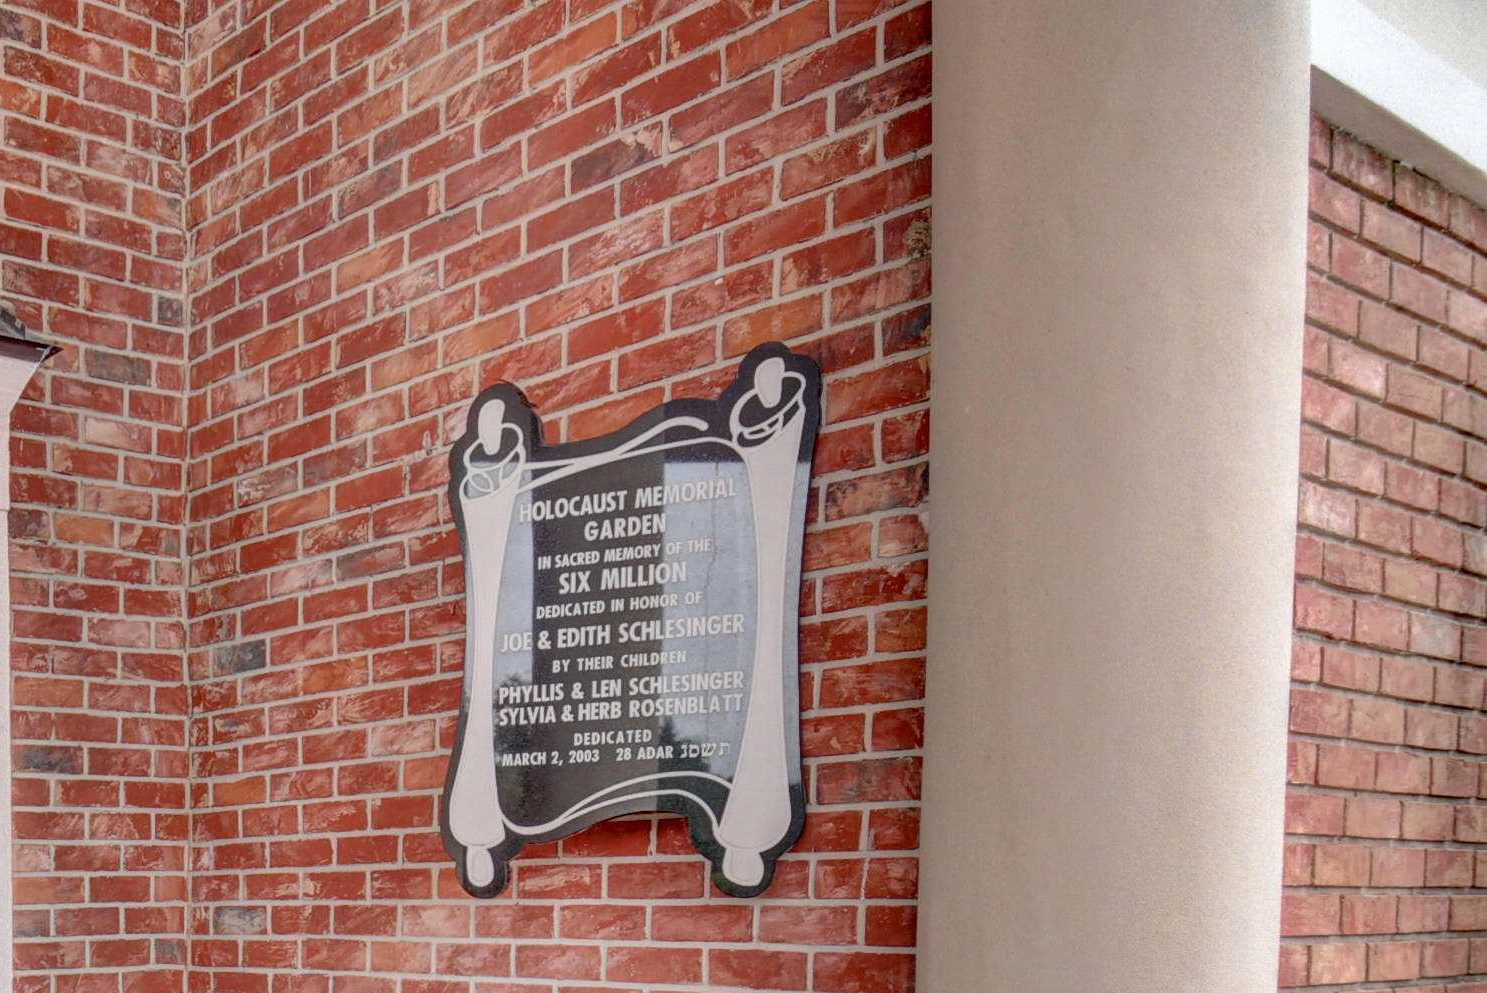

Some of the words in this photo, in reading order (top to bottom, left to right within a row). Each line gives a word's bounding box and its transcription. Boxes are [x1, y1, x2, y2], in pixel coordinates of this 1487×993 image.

[519, 490, 627, 522] HOLOCAUST
[635, 478, 737, 509] MEMORIAL
[584, 513, 666, 541] GARDEN
[538, 556, 551, 570] IN
[555, 550, 600, 568] SACRED
[604, 543, 661, 563] MEMORY
[666, 541, 682, 555] OF
[687, 538, 712, 552] THE
[558, 572, 590, 594] SIX
[601, 561, 687, 591] MILLION
[536, 600, 605, 620] DEDICATED
[611, 598, 624, 612] IN
[630, 593, 678, 611] HONOR
[685, 591, 703, 604] OF
[500, 632, 533, 653] JOE
[537, 631, 552, 650] &
[557, 624, 611, 649] EDITH
[618, 614, 745, 643] SCHLESINGER
[552, 659, 570, 673] BY
[577, 656, 614, 671] THEIR
[620, 650, 686, 668] CHILDREN
[499, 683, 564, 705] PHYLLIS
[571, 681, 585, 699] &
[591, 679, 622, 698] LEN
[629, 671, 744, 695] SCHLESINGER
[499, 705, 556, 726] SYLVIA
[561, 704, 574, 722] &
[578, 701, 622, 721] HERB
[629, 694, 743, 718] ROSENBLATT
[574, 729, 652, 746] DEDICATED
[502, 752, 547, 767] MARCH
[550, 751, 563, 767] 2,
[568, 750, 600, 764] 2003
[616, 747, 631, 762] 28
[637, 746, 673, 760] ADAR
